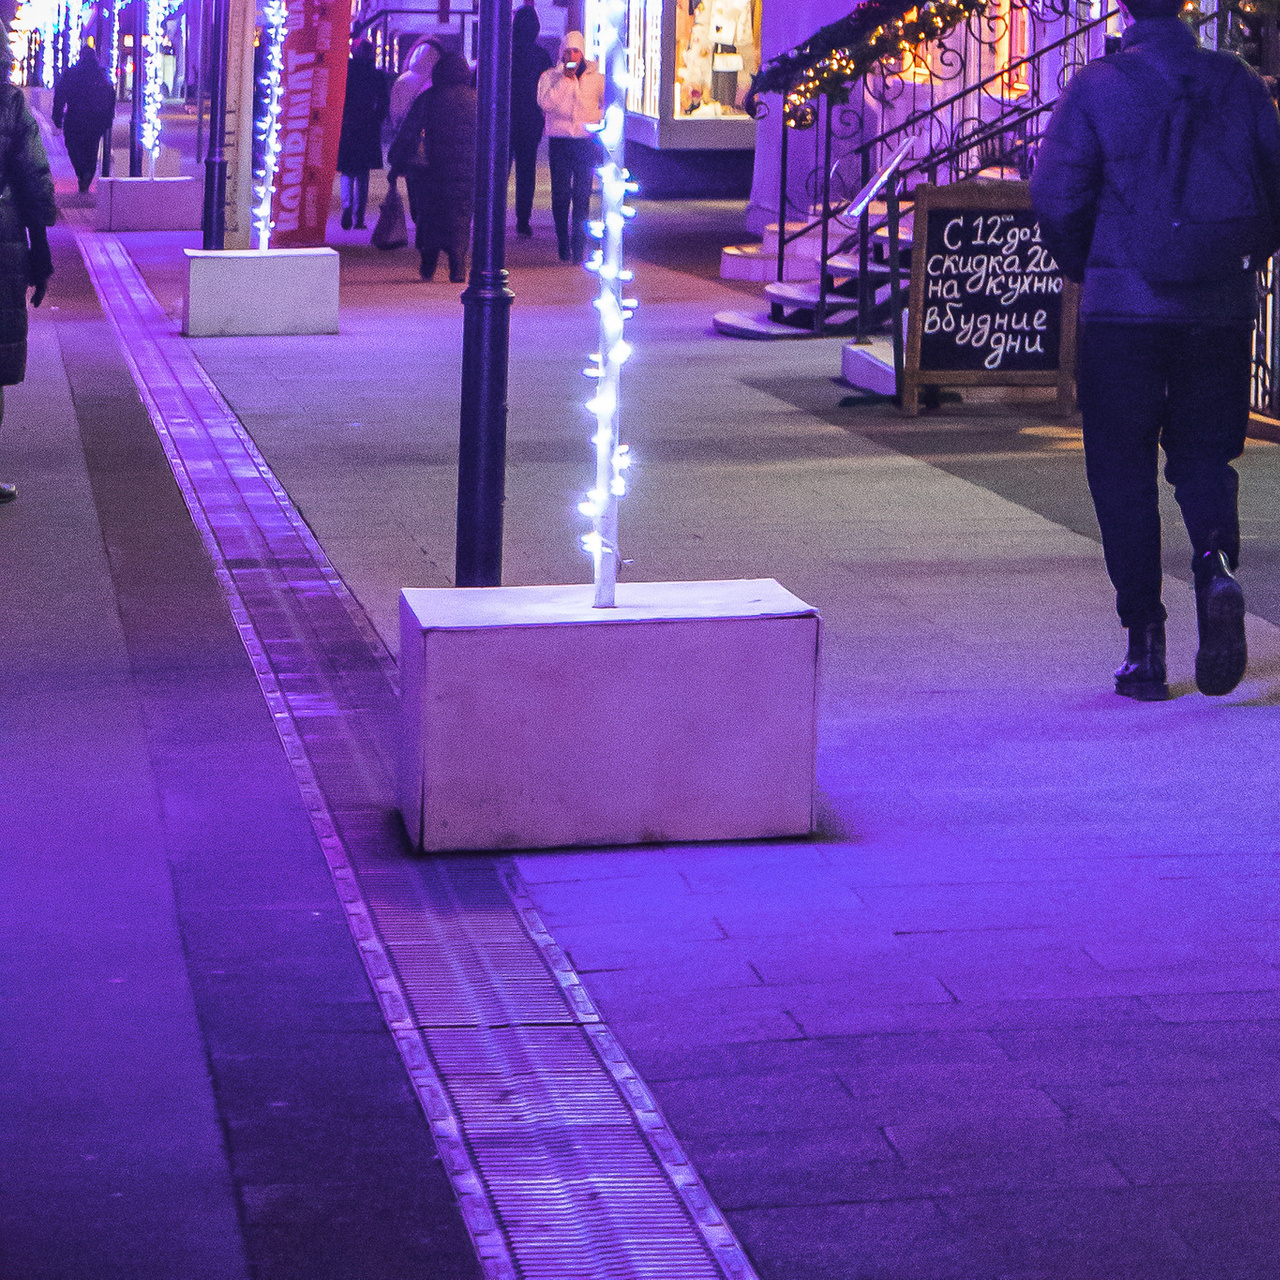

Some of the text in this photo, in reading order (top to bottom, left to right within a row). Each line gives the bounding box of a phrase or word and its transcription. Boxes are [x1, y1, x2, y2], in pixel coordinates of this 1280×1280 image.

[1031, 221, 1042, 242] 1
[927, 244, 1059, 293] скидка 20
[928, 274, 1063, 305] на кухню
[984, 332, 1044, 369] дни
